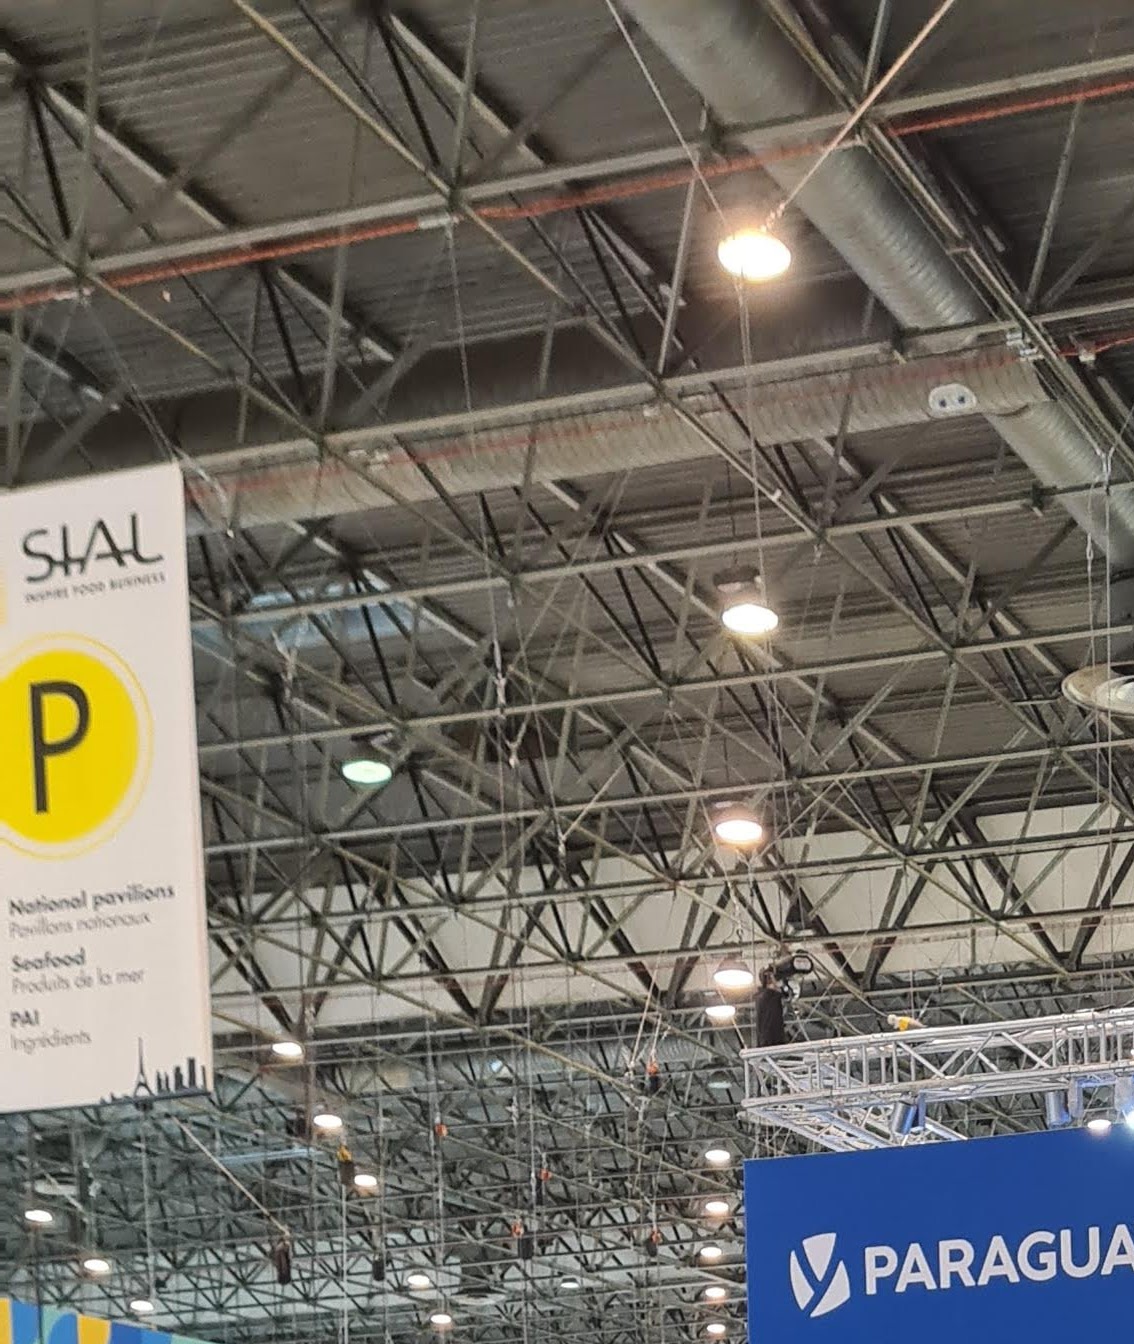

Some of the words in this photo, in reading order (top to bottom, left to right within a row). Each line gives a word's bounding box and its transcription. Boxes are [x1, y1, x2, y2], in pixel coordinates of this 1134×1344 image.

[22, 512, 164, 583] SIAL
[28, 680, 90, 816] P
[9, 890, 87, 916] National
[12, 946, 87, 973] Seafood
[10, 1009, 40, 1028] PAI
